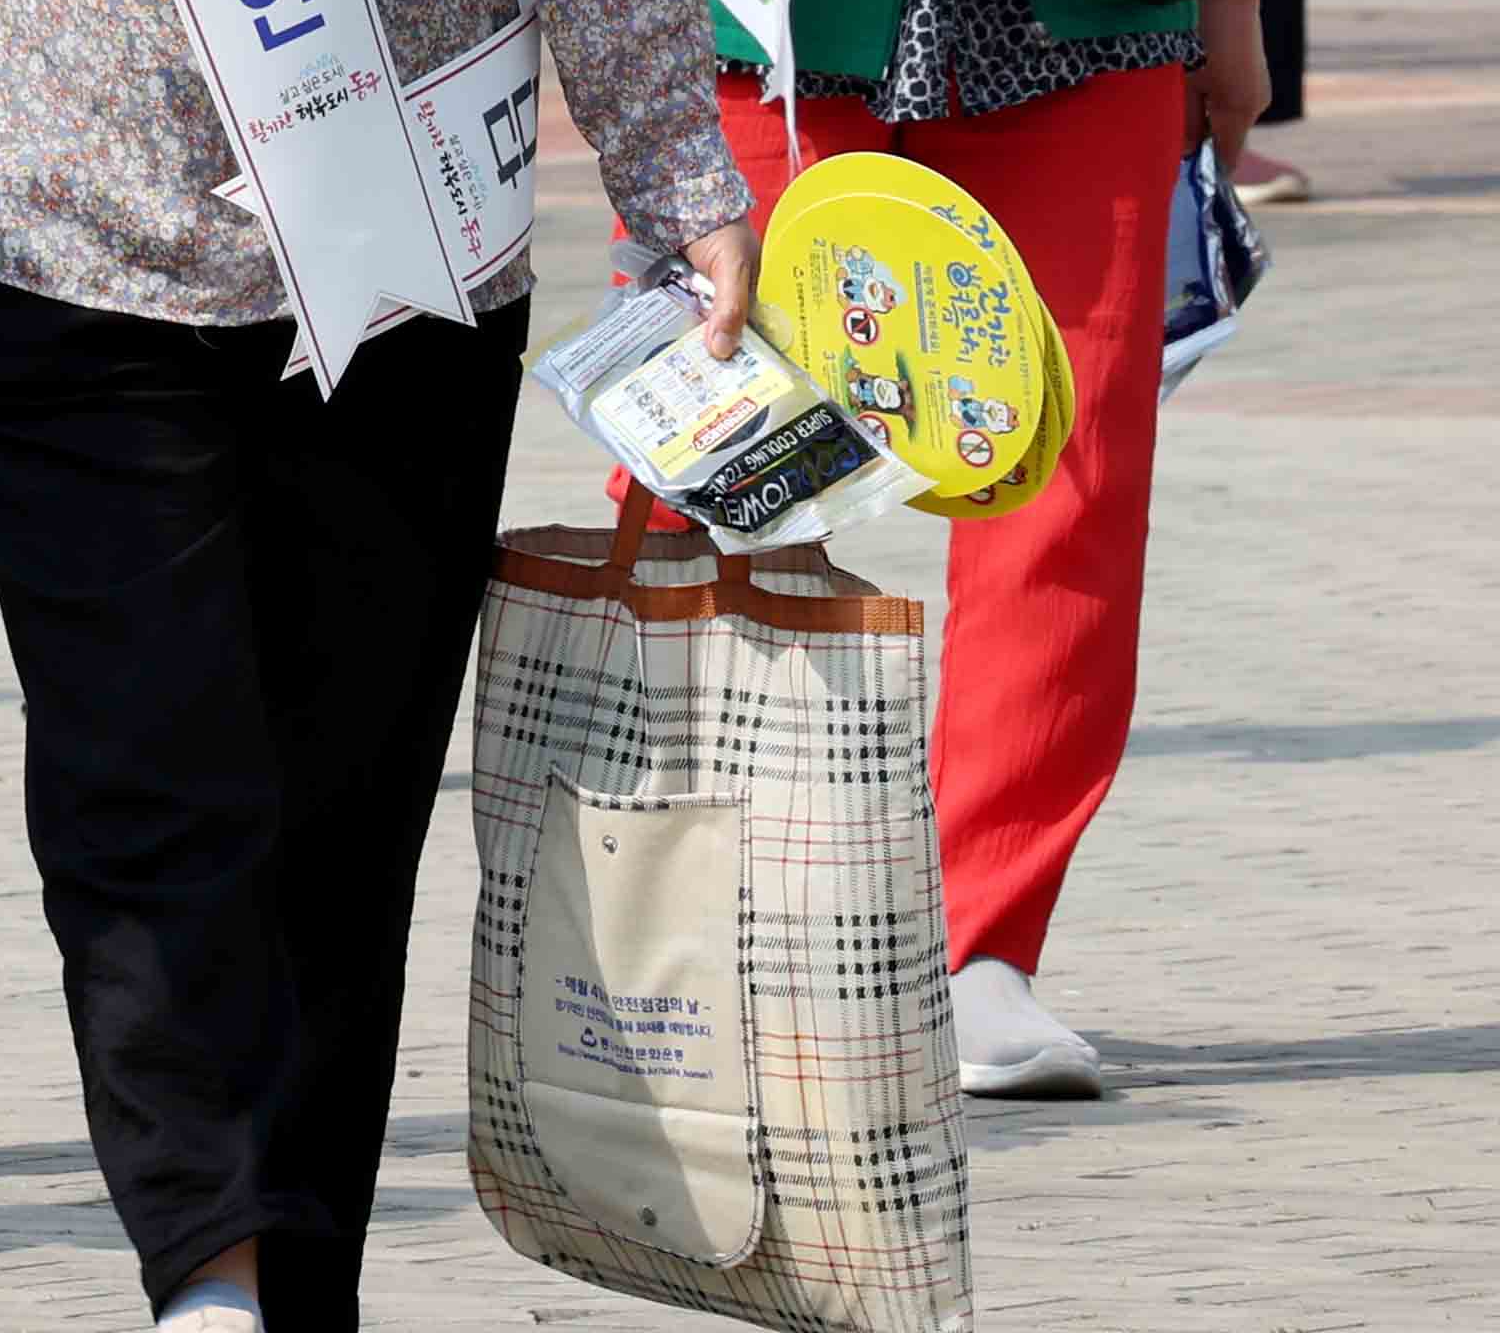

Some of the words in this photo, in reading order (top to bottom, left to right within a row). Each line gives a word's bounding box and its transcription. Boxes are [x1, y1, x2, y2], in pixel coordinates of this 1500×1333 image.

[247, 111, 293, 145] 활기찬
[295, 87, 349, 121] 행복도시
[348, 68, 382, 101] 동구
[798, 408, 834, 438] SUPER
[745, 426, 799, 469] COOLING
[611, 996, 684, 1014] 안전점검의
